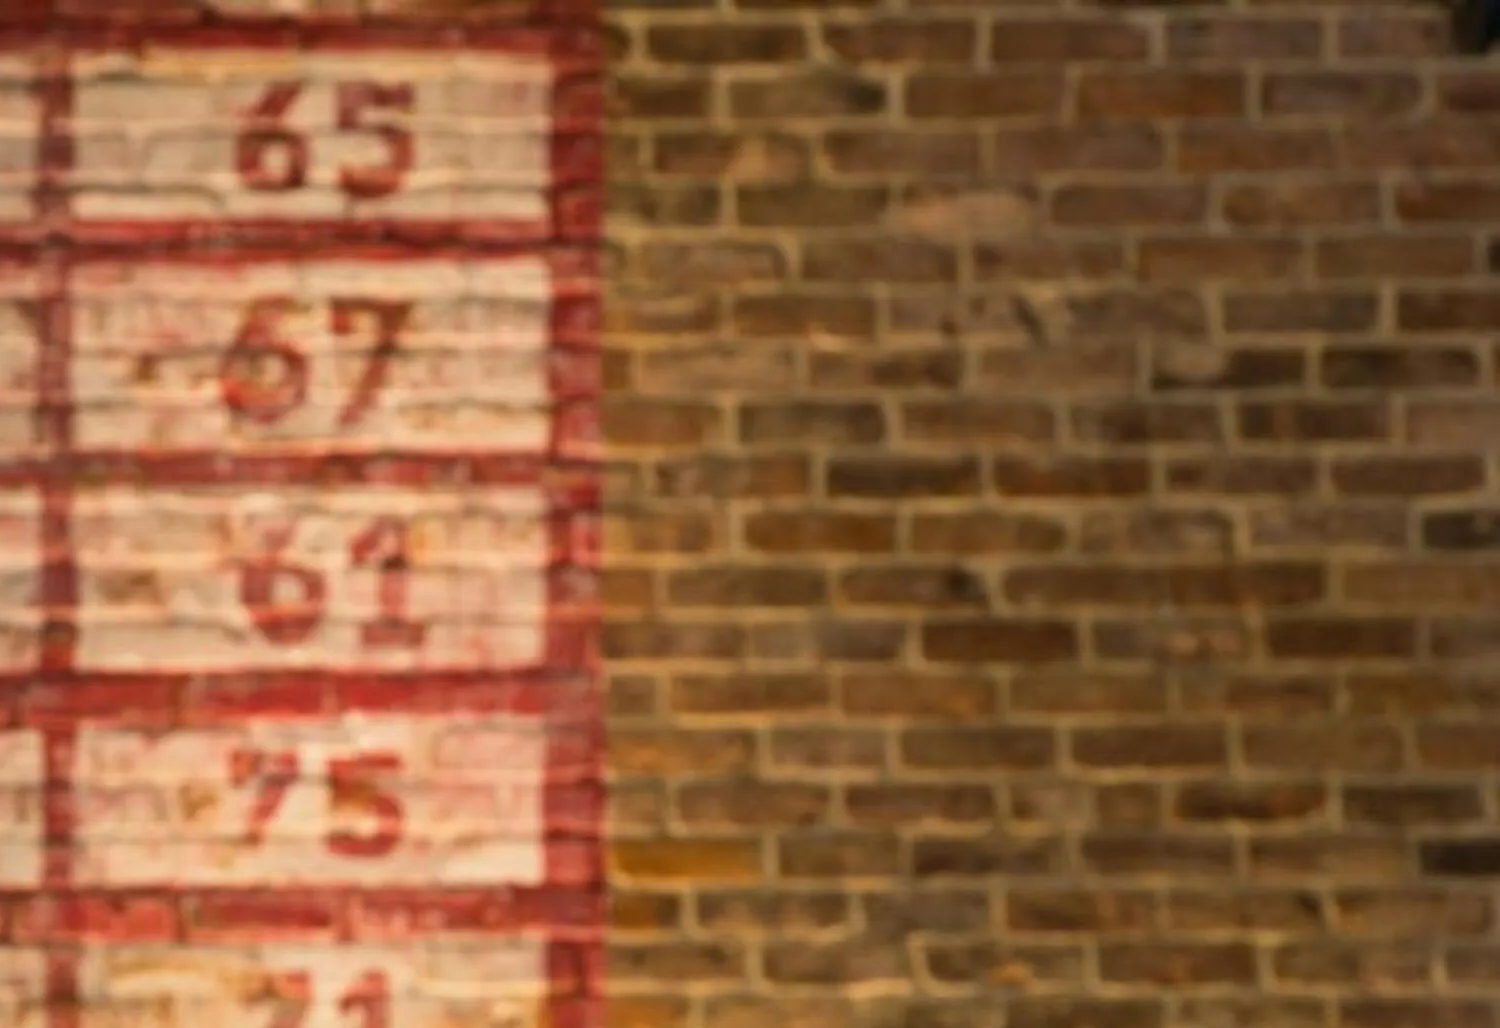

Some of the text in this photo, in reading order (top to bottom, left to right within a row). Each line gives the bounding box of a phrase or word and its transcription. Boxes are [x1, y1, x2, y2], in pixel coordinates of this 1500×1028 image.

[236, 79, 416, 199] 65
[221, 294, 413, 427] 67
[233, 510, 426, 647] 61
[224, 745, 408, 860] 75
